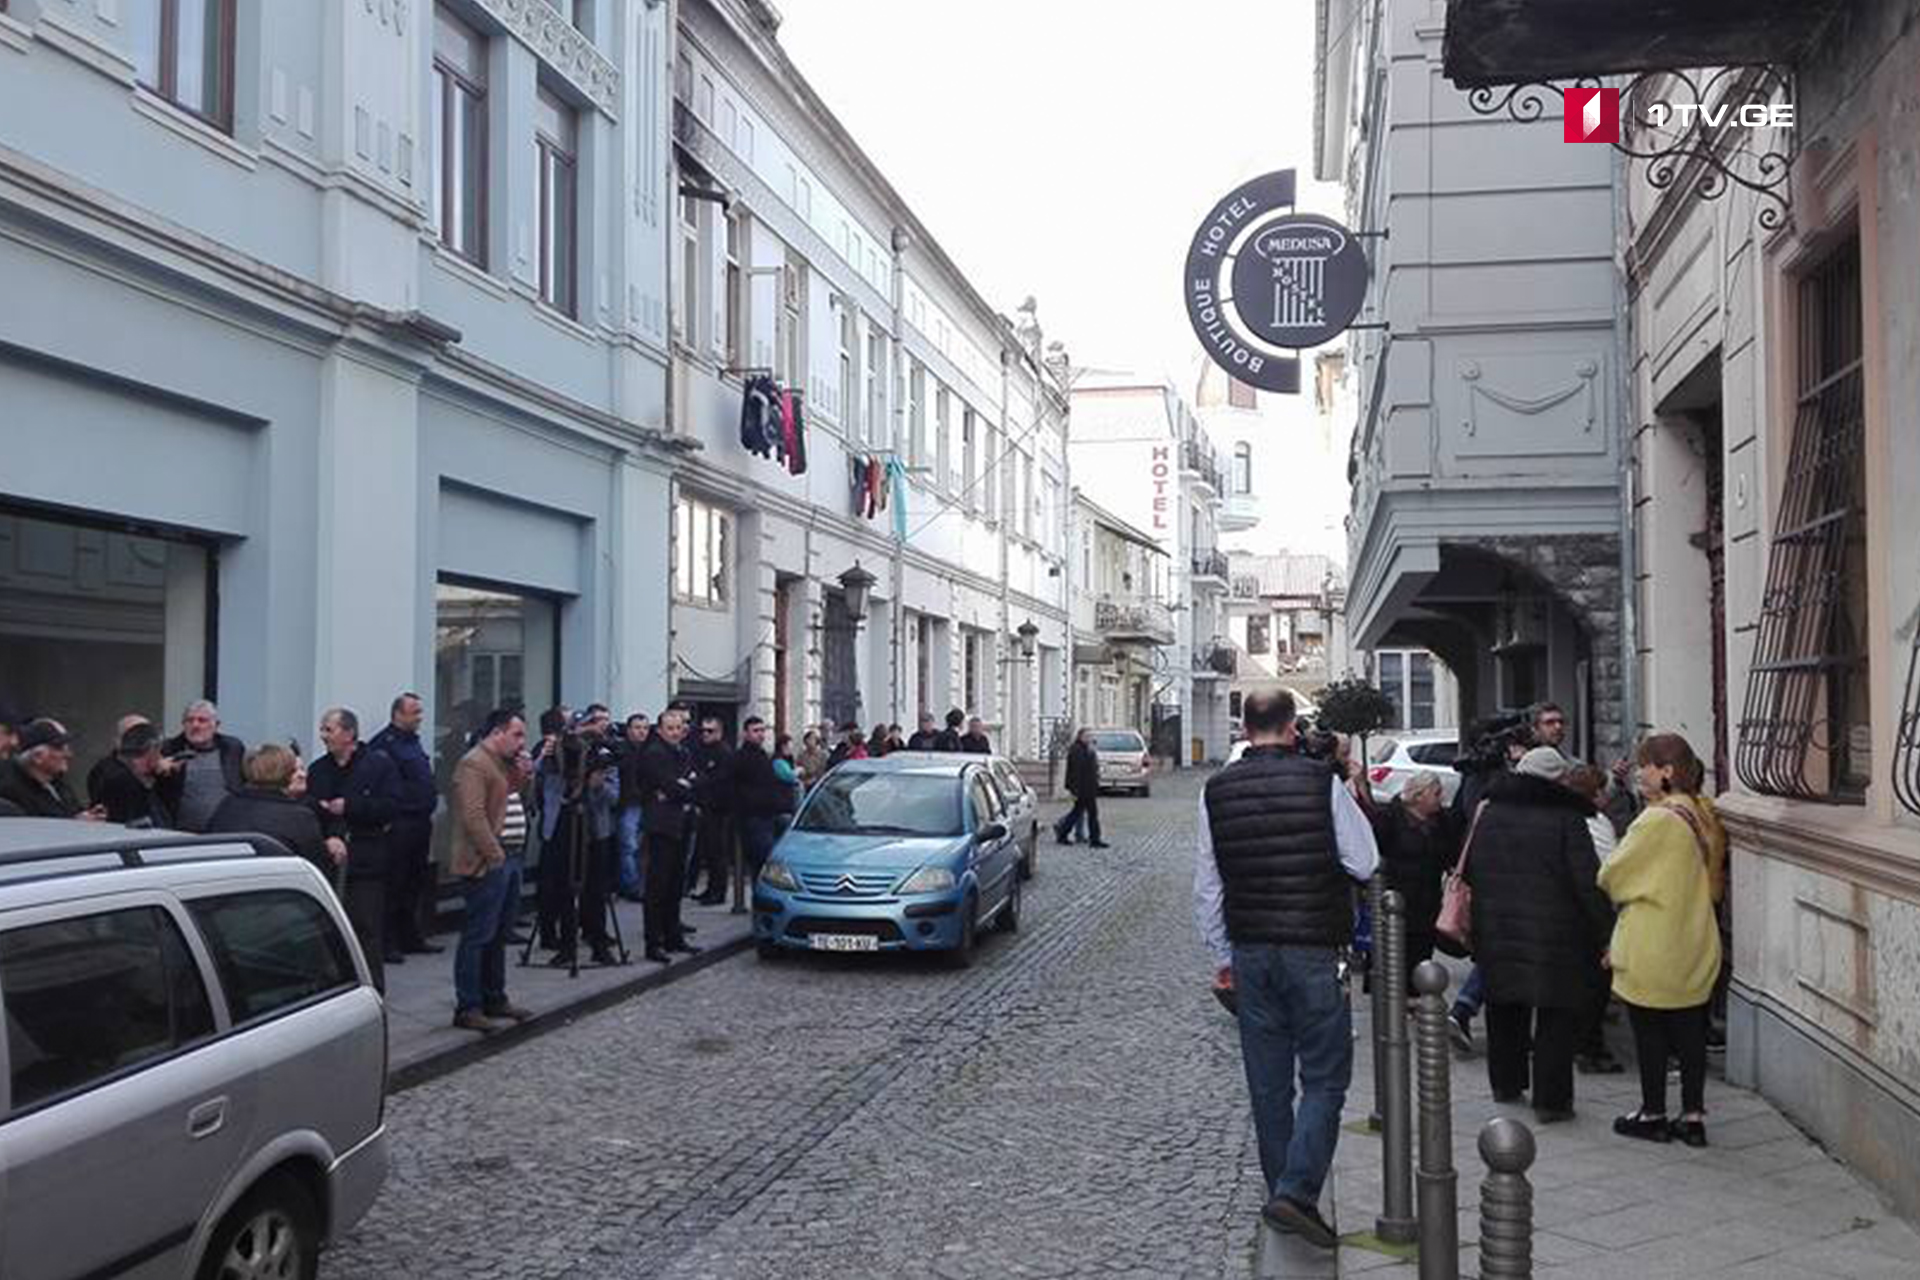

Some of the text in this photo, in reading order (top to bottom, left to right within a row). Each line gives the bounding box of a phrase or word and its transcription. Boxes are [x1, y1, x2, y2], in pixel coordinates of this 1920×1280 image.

[1195, 196, 1264, 374] BOUTIQUE HOTEL
[1267, 237, 1332, 251] MEDUSA
[1152, 446, 1169, 529] HOTEL
